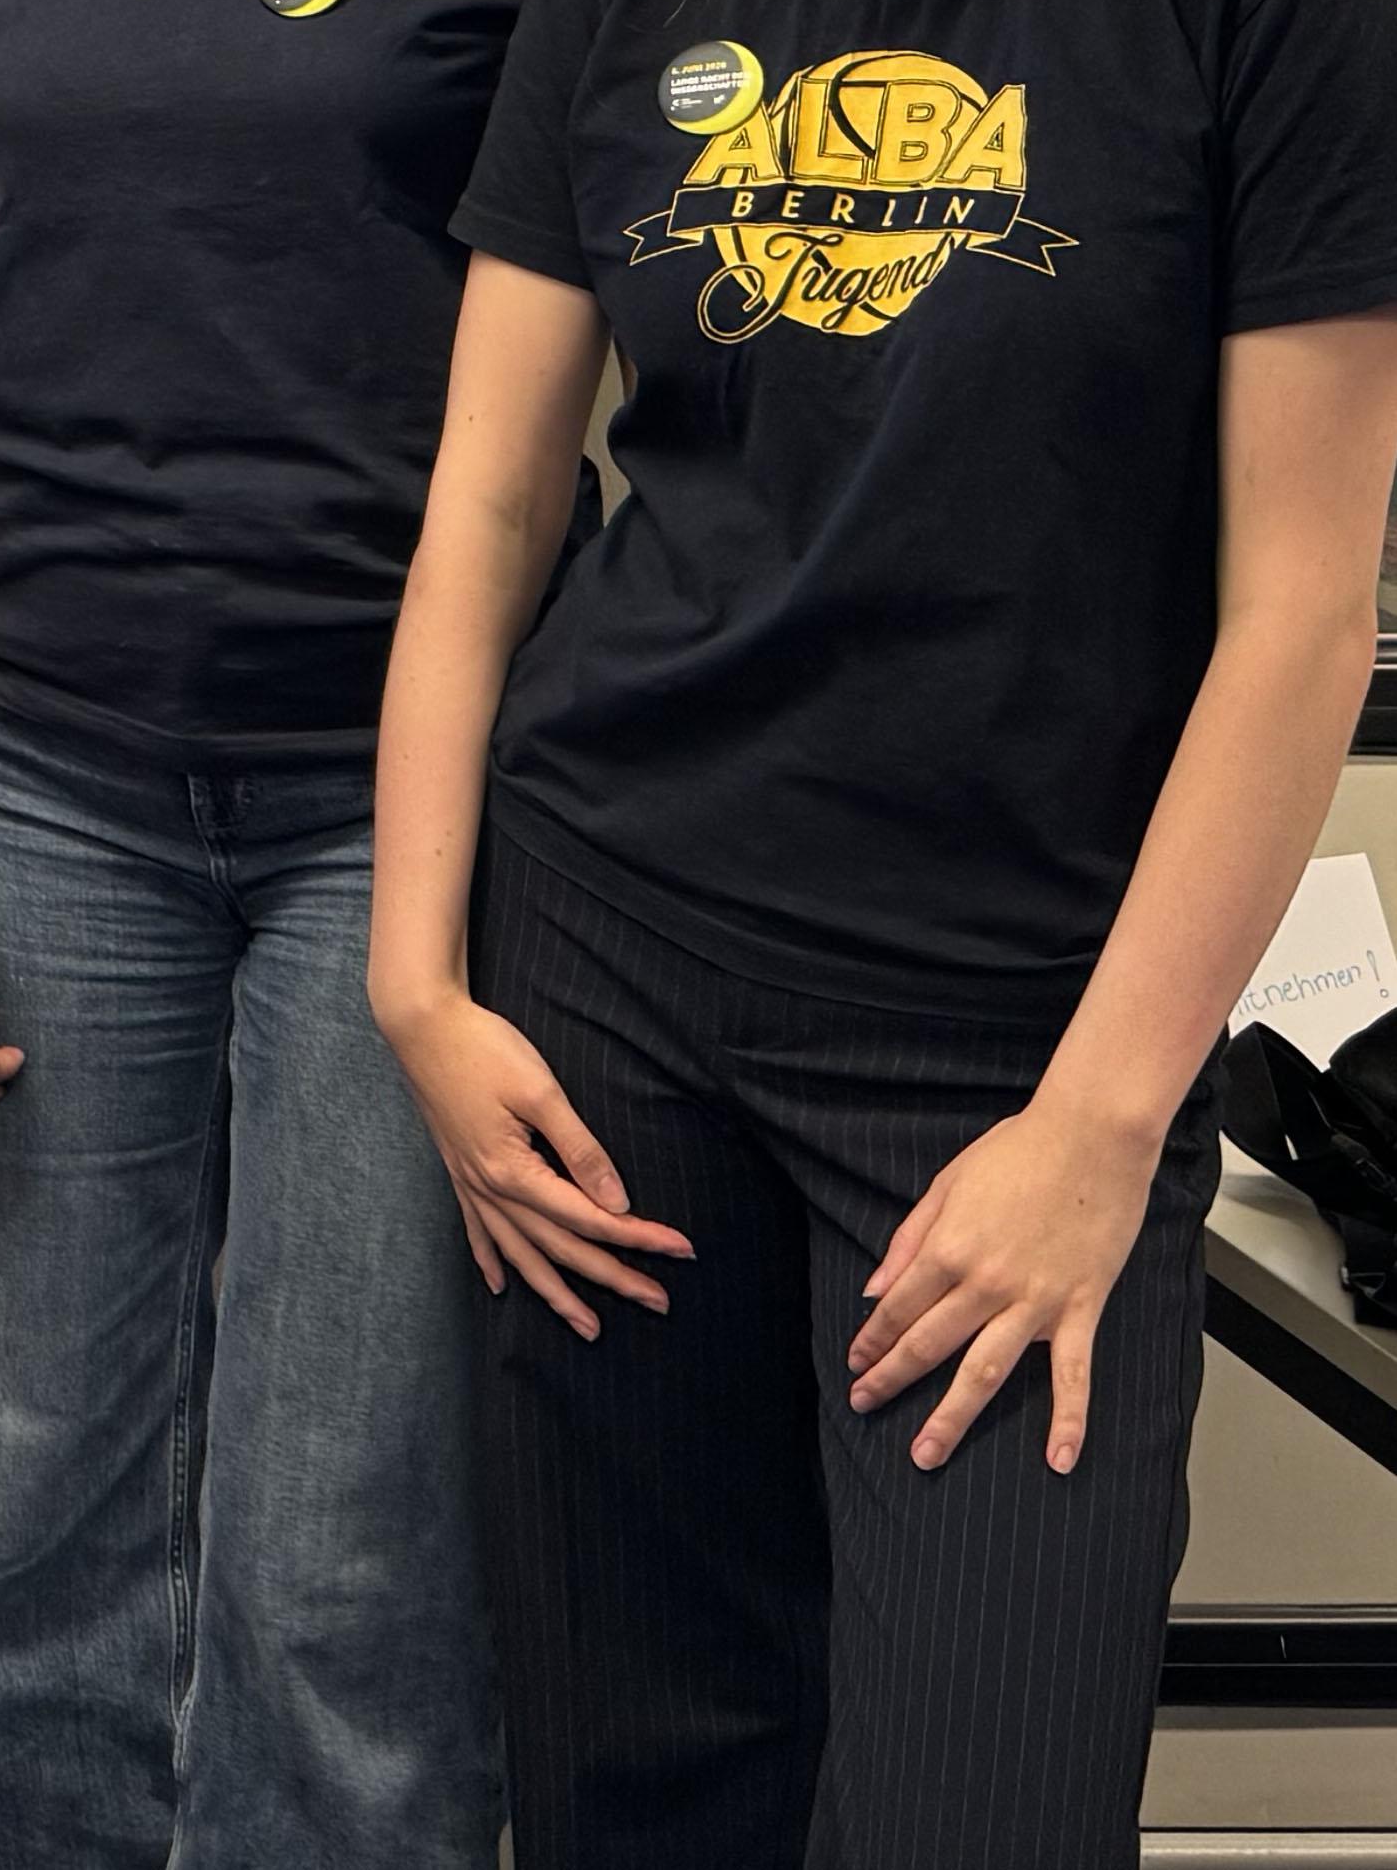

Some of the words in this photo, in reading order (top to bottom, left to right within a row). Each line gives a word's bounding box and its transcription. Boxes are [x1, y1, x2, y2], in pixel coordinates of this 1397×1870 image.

[683, 78, 1026, 191] ALBA
[731, 190, 976, 227] BERLIN
[697, 231, 951, 344] Jugend
